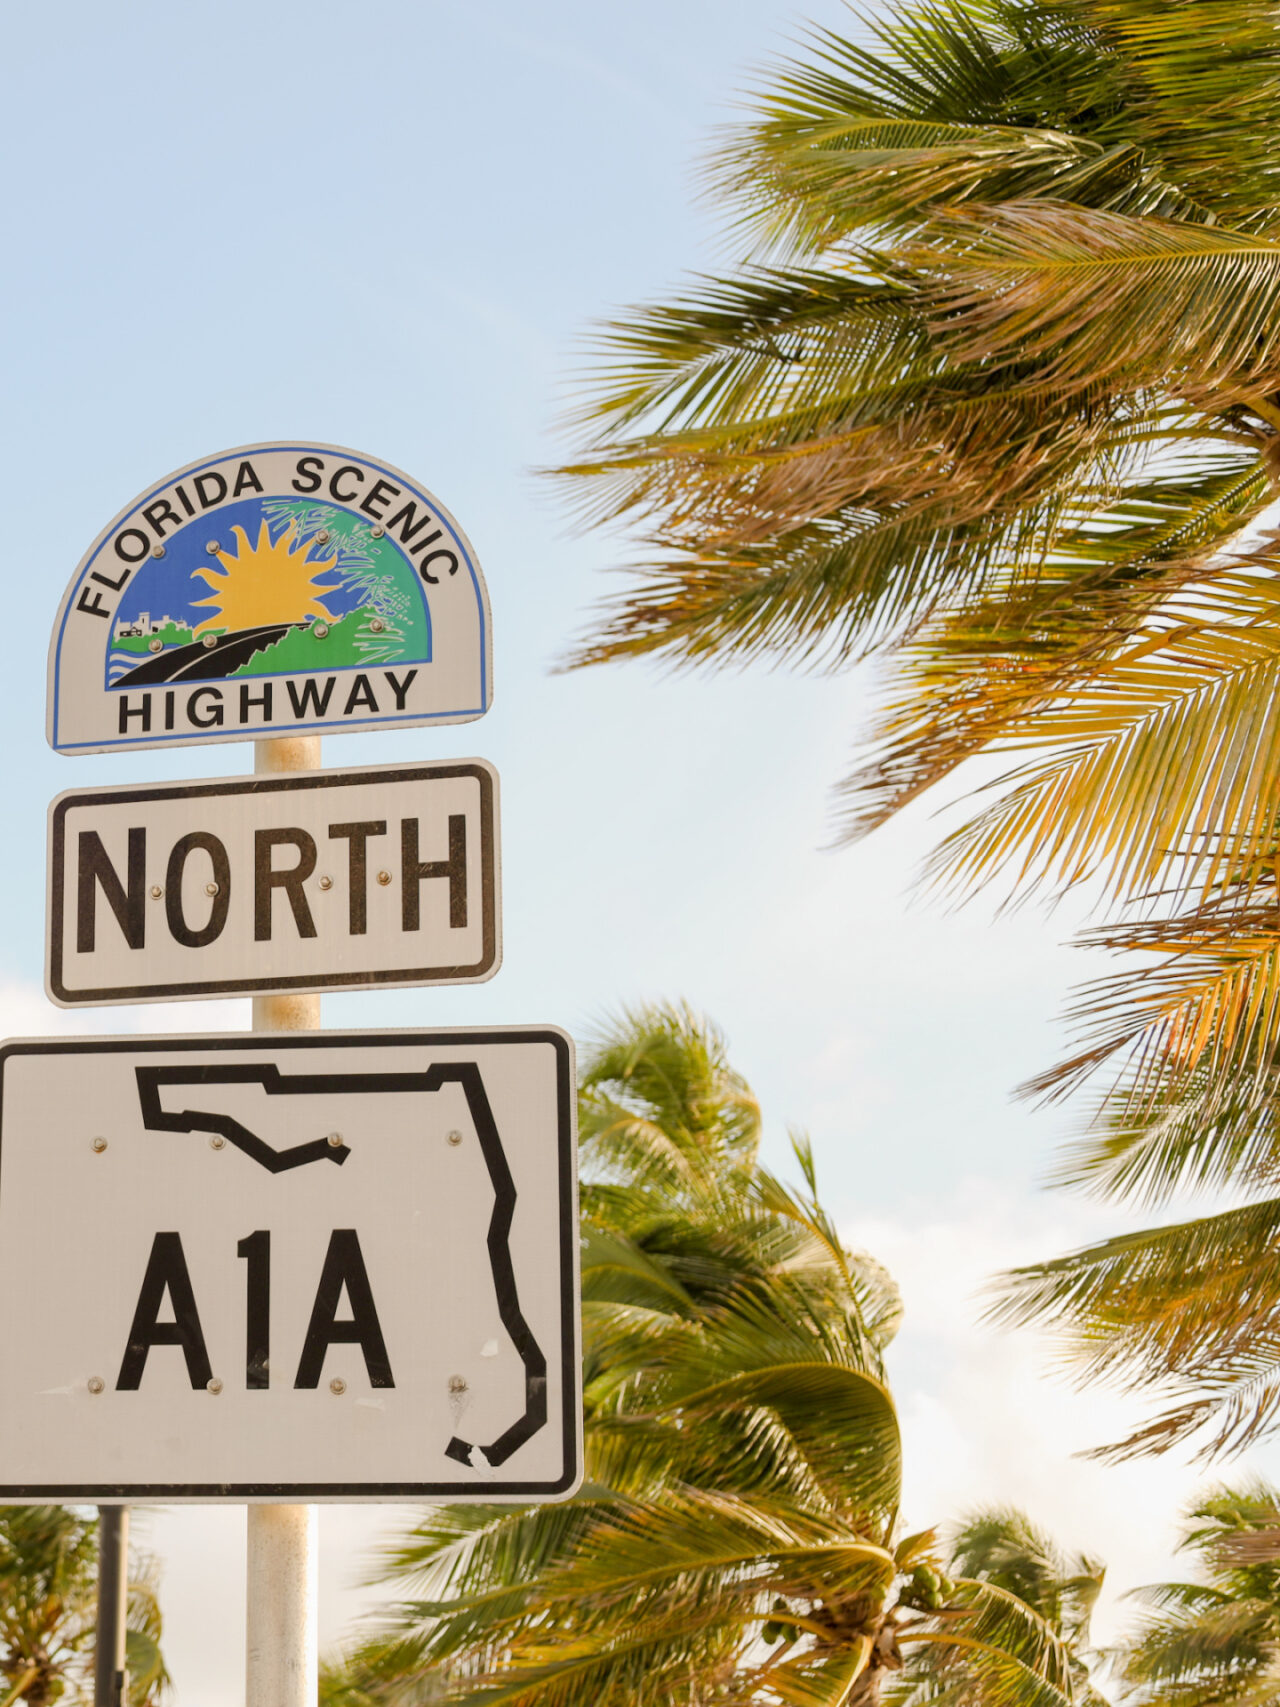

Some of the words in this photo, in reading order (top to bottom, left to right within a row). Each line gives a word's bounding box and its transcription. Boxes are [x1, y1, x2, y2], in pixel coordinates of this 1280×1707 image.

[76, 461, 265, 619] FLORIDA
[291, 456, 460, 586] SCENIC
[118, 669, 419, 735] HIGHWAY
[76, 814, 468, 954] NORTH
[114, 1228, 396, 1392] A1A
